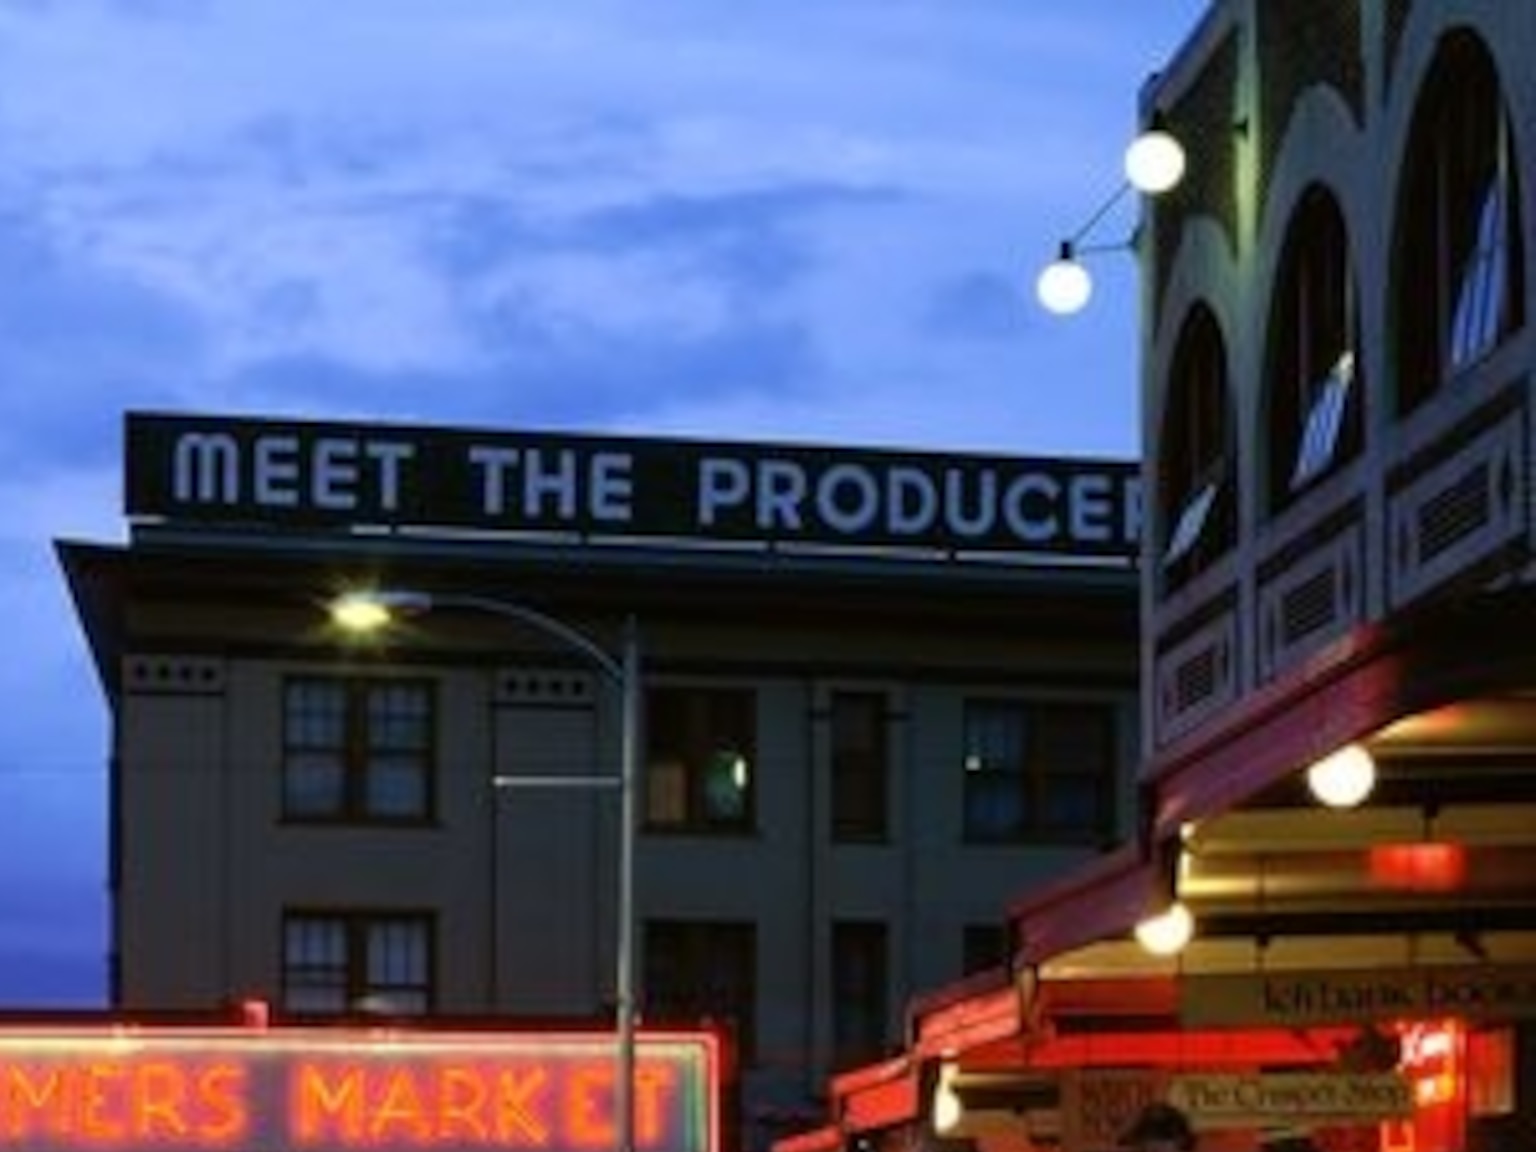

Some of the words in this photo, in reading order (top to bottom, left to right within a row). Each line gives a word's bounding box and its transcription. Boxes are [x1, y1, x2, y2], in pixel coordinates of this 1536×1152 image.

[173, 431, 414, 510] MEET
[469, 445, 632, 521] THE
[296, 1064, 673, 1145] MARKET
